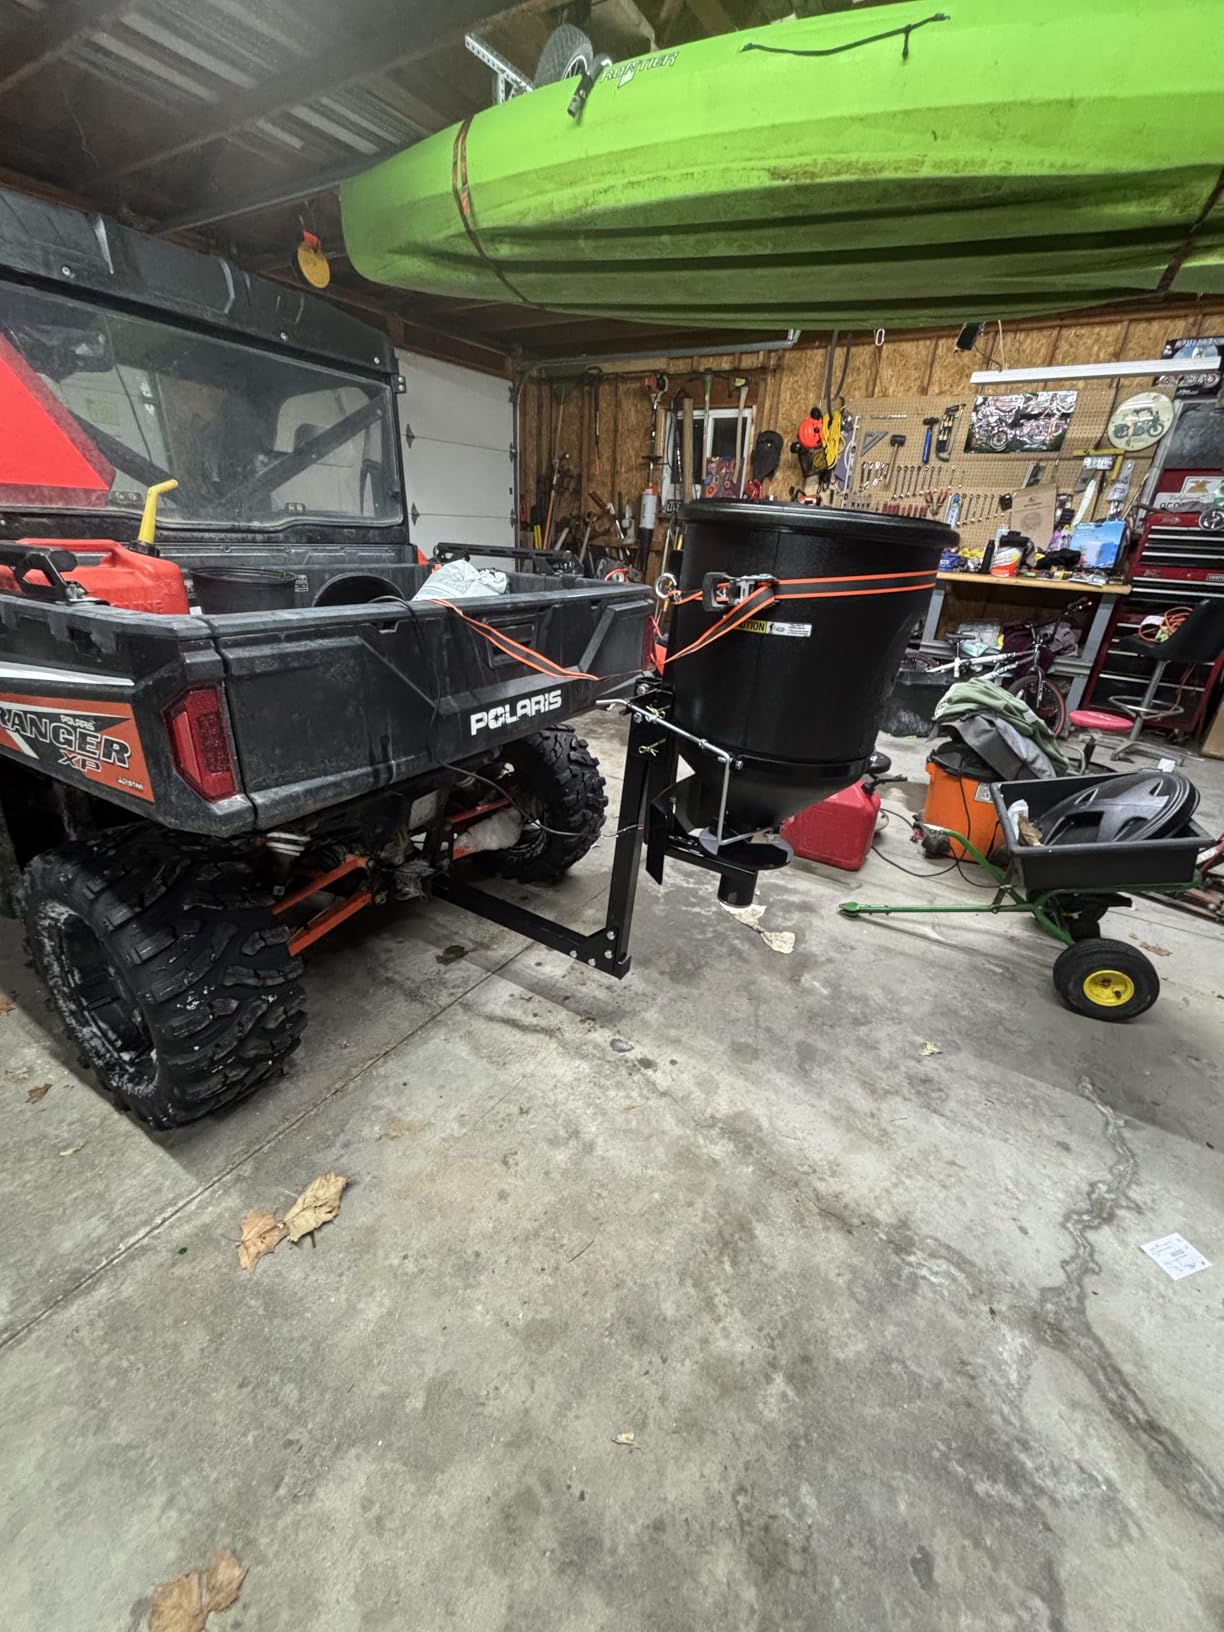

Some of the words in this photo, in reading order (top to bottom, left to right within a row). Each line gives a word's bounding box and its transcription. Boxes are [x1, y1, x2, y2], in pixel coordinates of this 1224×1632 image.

[600, 52, 679, 88] RONTIER
[737, 620, 765, 631] UTION
[470, 690, 562, 736] POLARIS
[57, 749, 101, 773] XP
